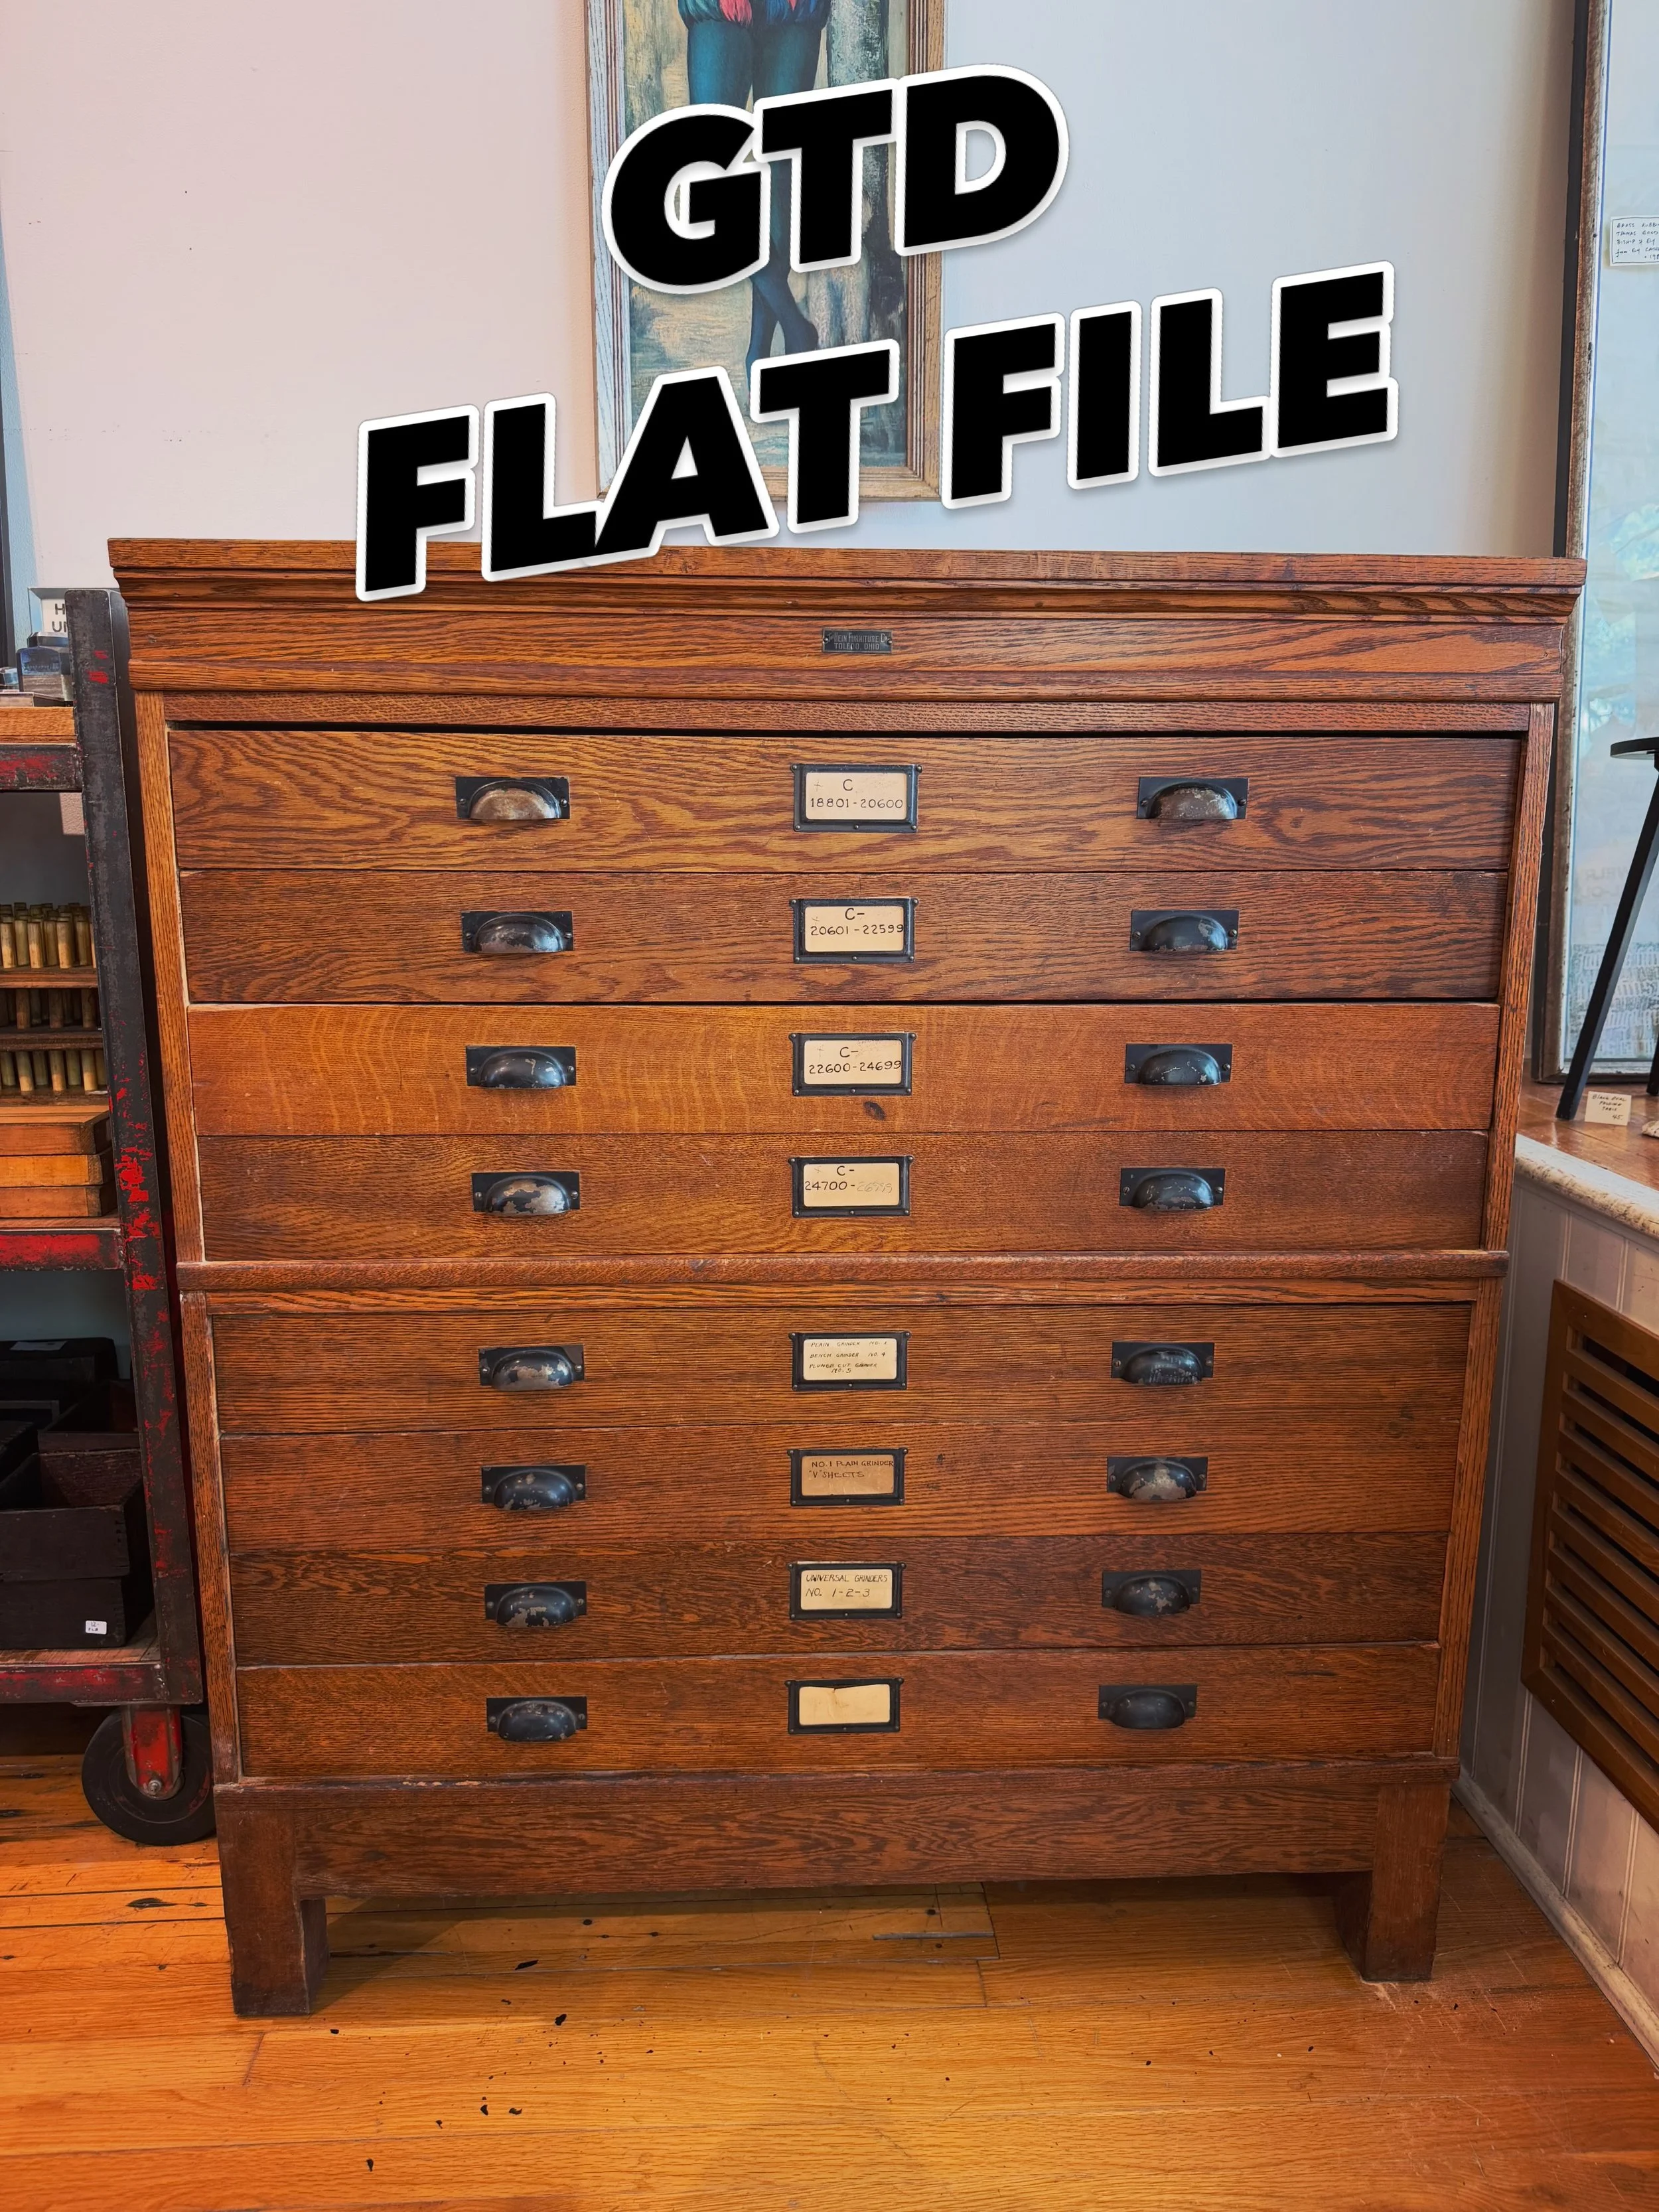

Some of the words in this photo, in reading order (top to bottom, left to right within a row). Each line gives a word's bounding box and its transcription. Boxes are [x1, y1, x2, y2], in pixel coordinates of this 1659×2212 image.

[843, 779, 853, 791] C
[845, 907, 865, 920] C-
[839, 1047, 859, 1059] C-
[809, 1061, 901, 1074] 22600-24699
[854, 1574, 888, 1583] GRINDERS
[806, 1587, 822, 1597] NO.
